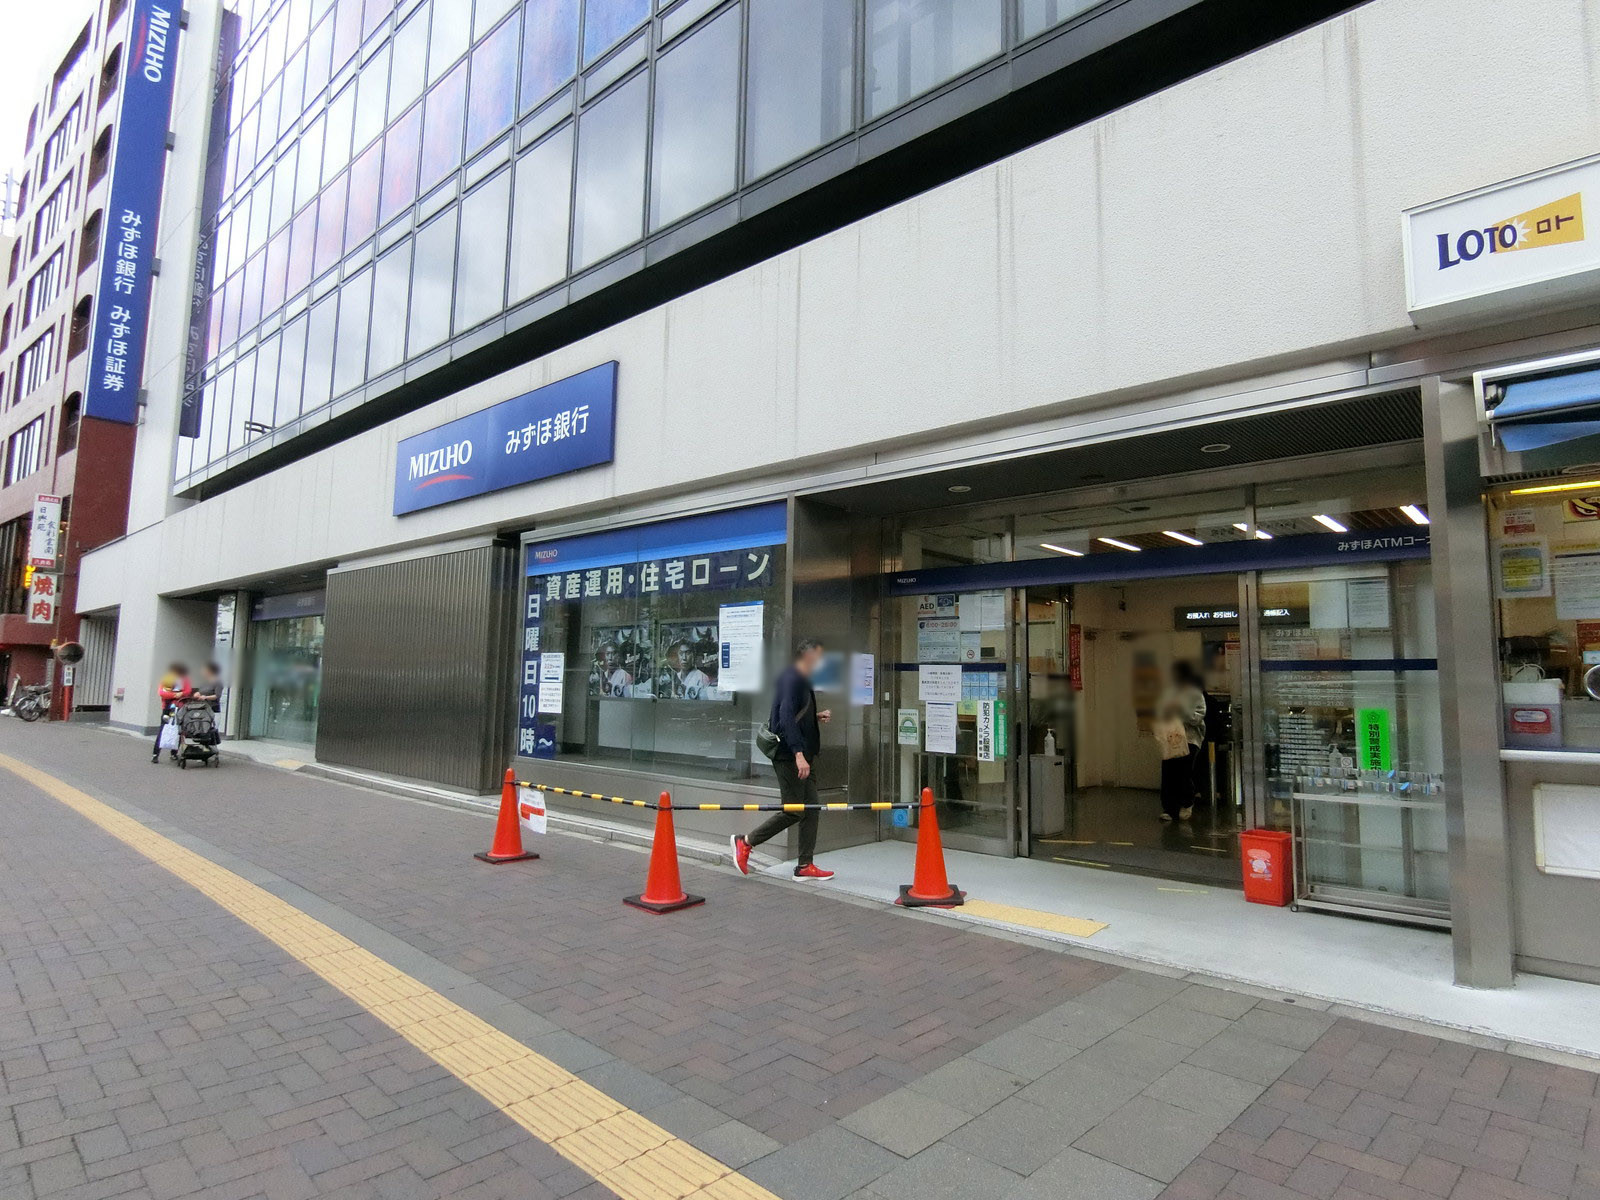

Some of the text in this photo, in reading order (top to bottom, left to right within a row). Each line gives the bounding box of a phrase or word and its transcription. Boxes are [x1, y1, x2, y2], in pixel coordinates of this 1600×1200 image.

[144, 4, 171, 83] MIZUHO
[1436, 223, 1518, 271] LOTO
[1536, 215, 1575, 235] ロト
[103, 210, 142, 392] みずほ銀行 みずほ証券
[505, 404, 590, 455] みずほ銀行
[409, 439, 473, 481] MIZUHO
[534, 549, 558, 559] MIZUHO
[545, 552, 770, 602] 資産運用・住宅ローン
[32, 575, 54, 622] 焼肉
